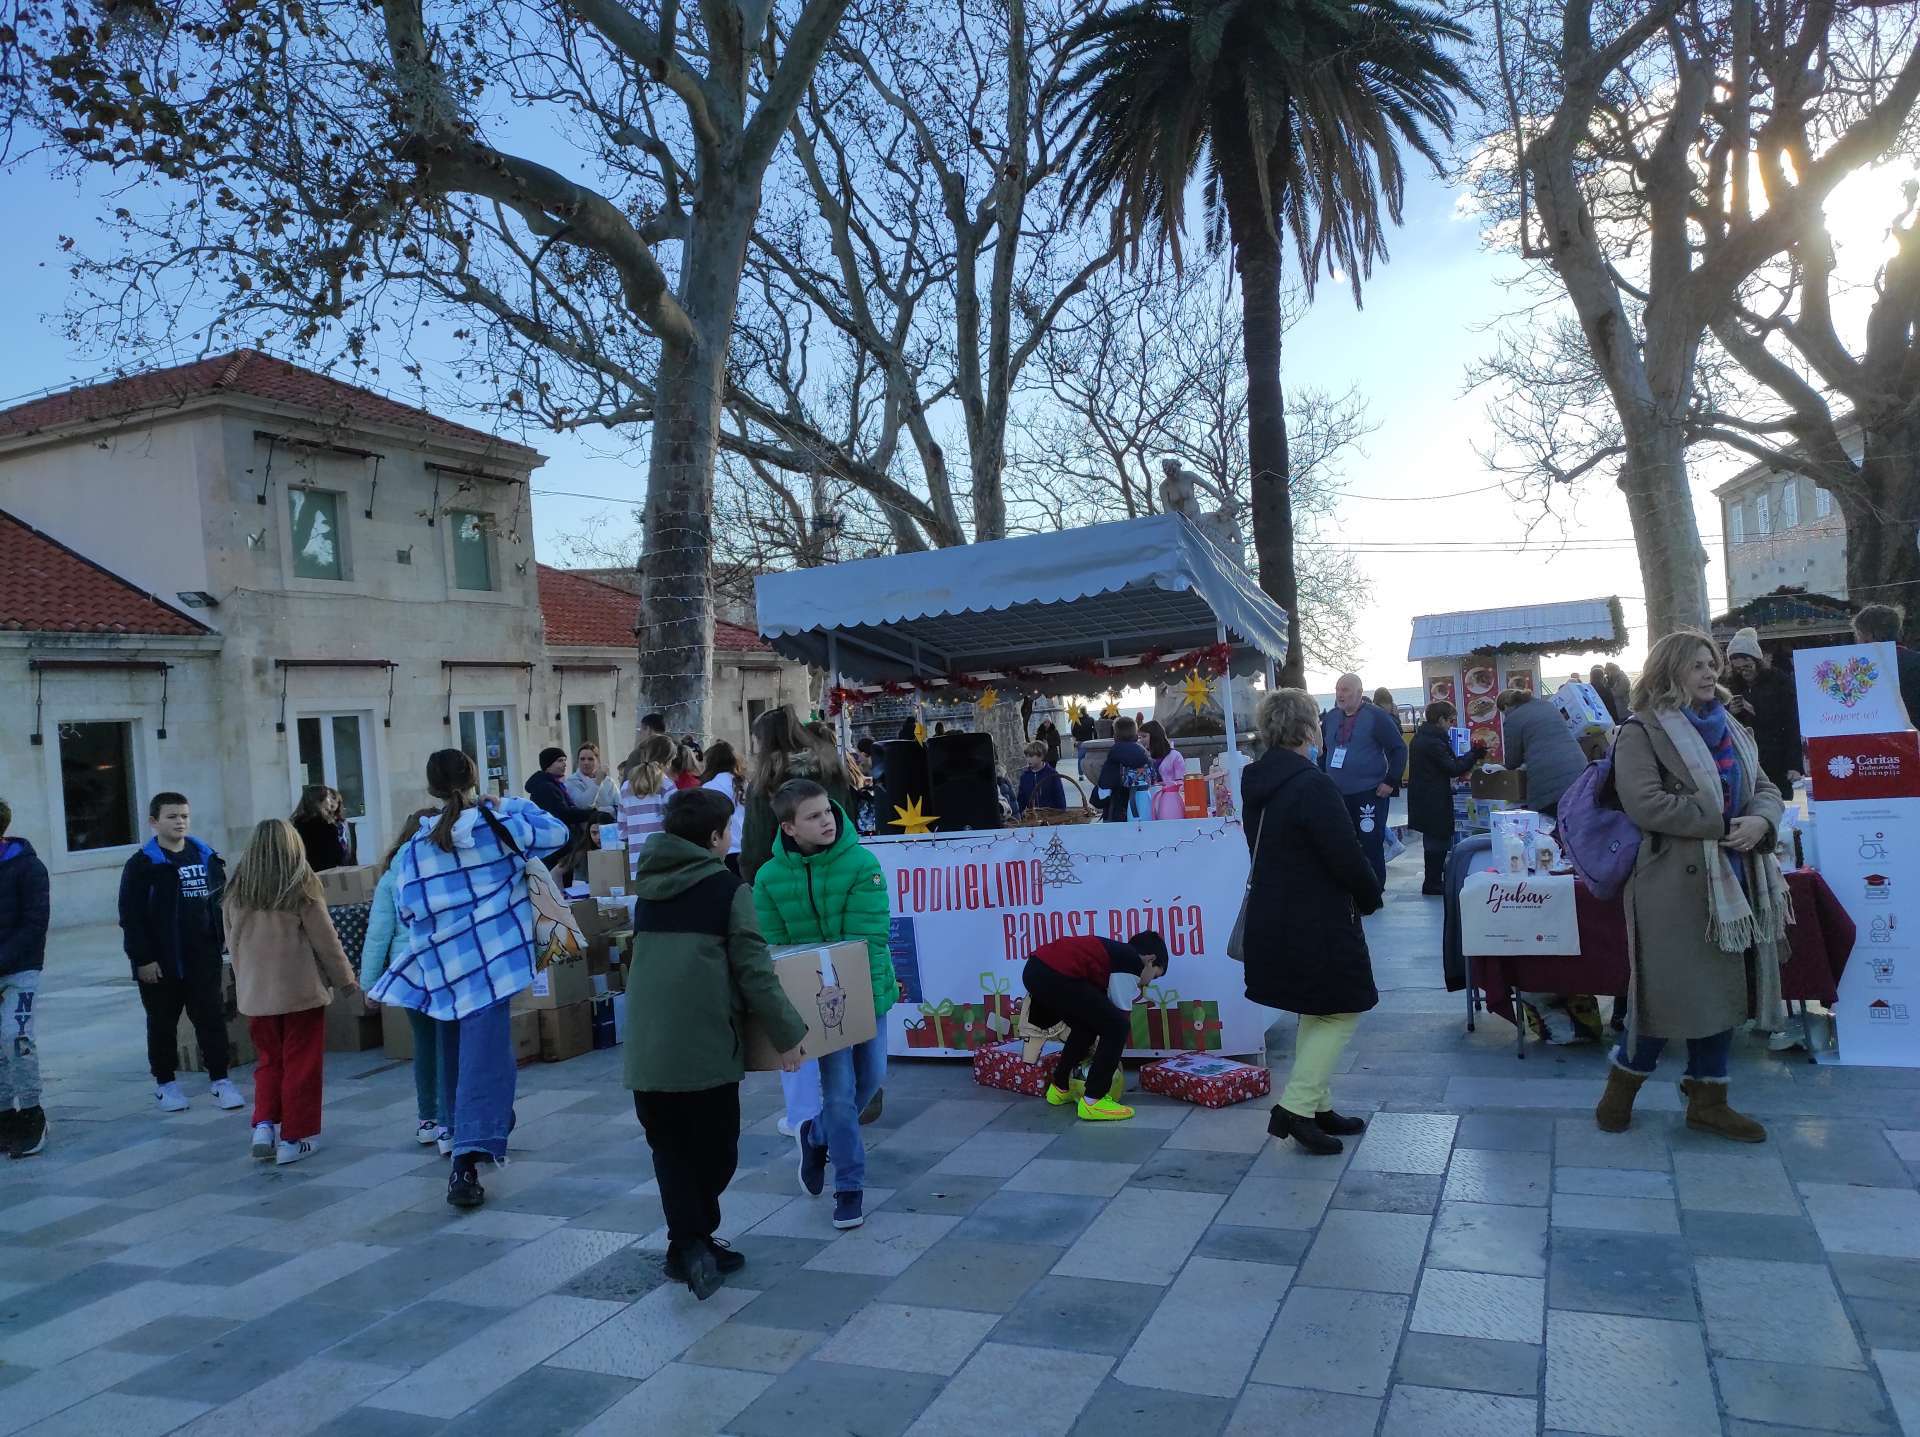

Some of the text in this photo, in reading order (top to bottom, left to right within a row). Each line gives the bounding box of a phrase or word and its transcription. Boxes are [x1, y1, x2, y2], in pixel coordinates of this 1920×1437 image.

[1856, 754, 1901, 765] Caritas
[182, 889, 198, 898] TIVE
[1486, 881, 1552, 913] Ljubav
